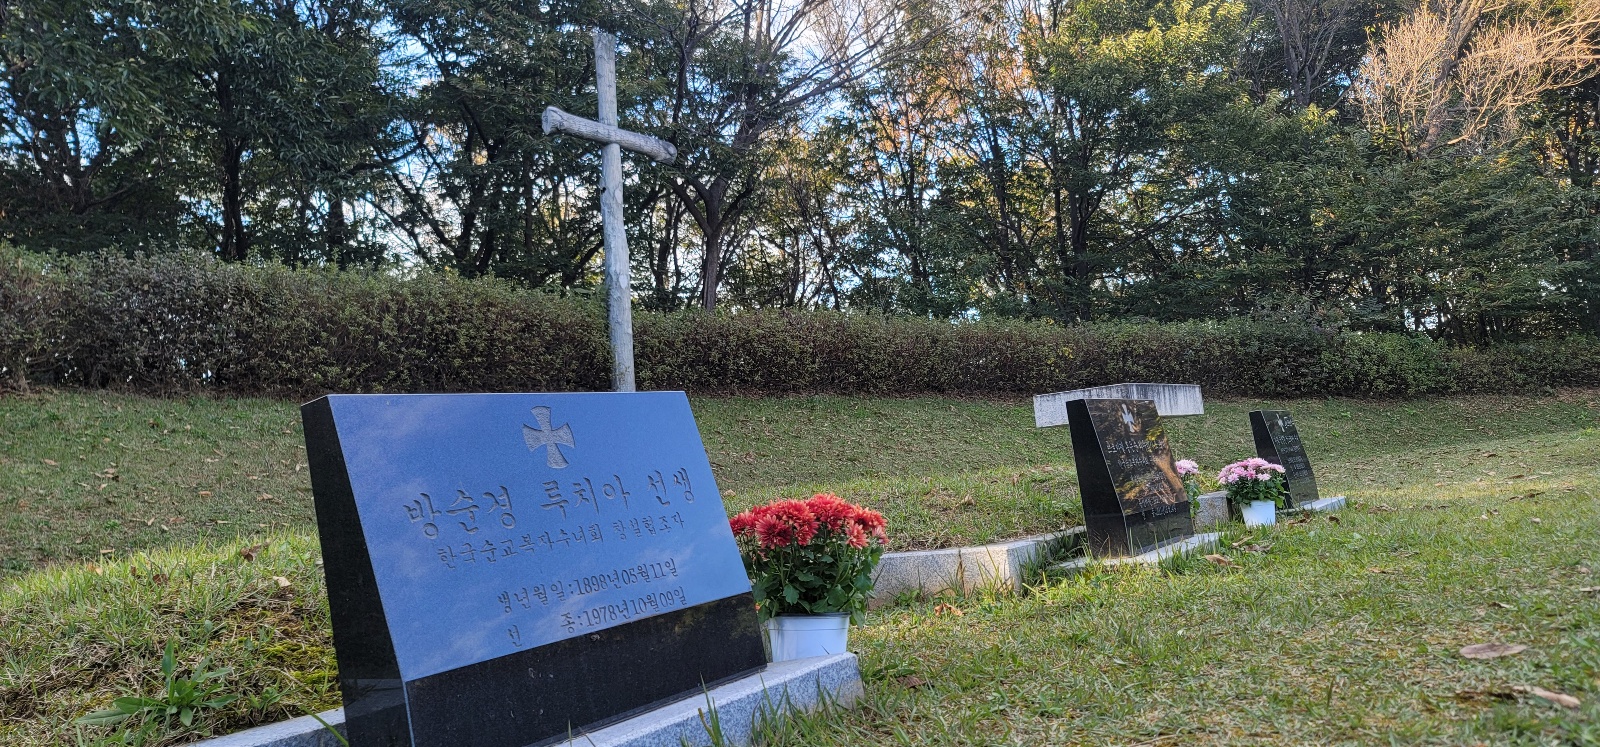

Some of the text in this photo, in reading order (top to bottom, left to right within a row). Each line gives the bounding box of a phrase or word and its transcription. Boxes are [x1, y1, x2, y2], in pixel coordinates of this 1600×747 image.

[403, 467, 695, 539] 방순경 루치아 선생
[437, 511, 685, 569] 한국순교복자수녀회 창설협조자
[507, 624, 523, 648] 선
